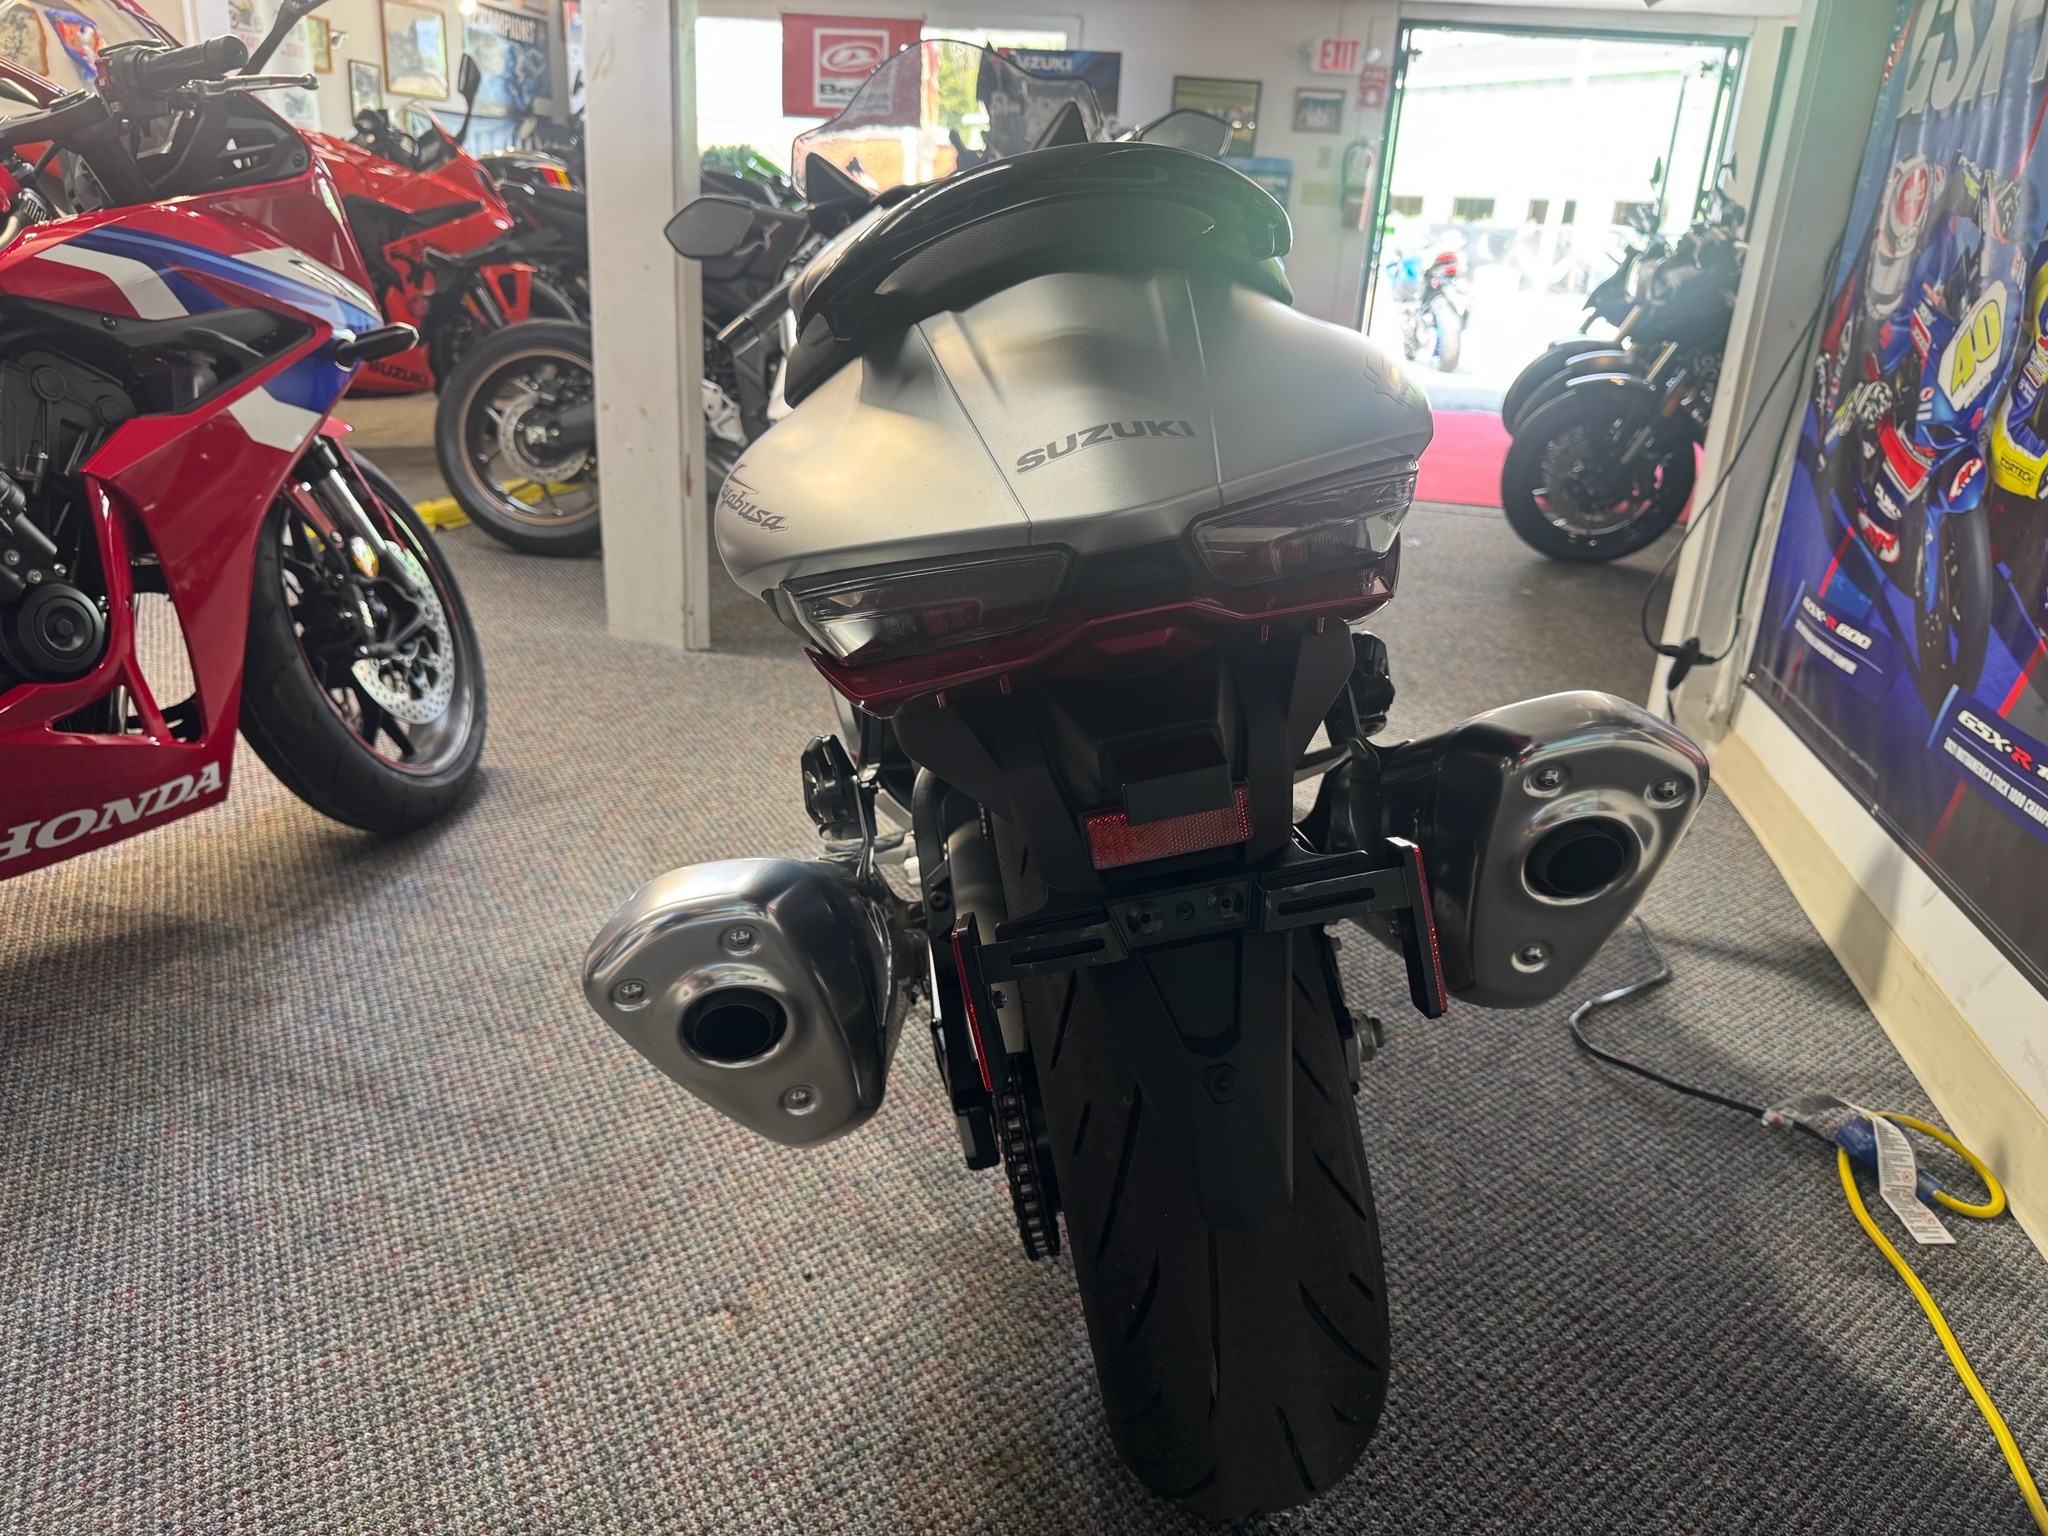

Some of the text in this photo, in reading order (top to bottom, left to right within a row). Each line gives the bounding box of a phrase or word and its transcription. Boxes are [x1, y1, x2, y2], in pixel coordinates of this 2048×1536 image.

[1017, 56, 1073, 72] UZUKI
[1319, 39, 1360, 71] EXIT
[1951, 299, 2001, 397] 40
[368, 361, 428, 386] SUZUKI
[1016, 420, 1197, 474] SUZUKI
[1835, 622, 1872, 650] 600
[0, 761, 223, 861] HONDA
[1989, 772, 2011, 797] STOCK
[2007, 786, 2027, 809] 1000
[2023, 798, 2048, 828] CHAMP
